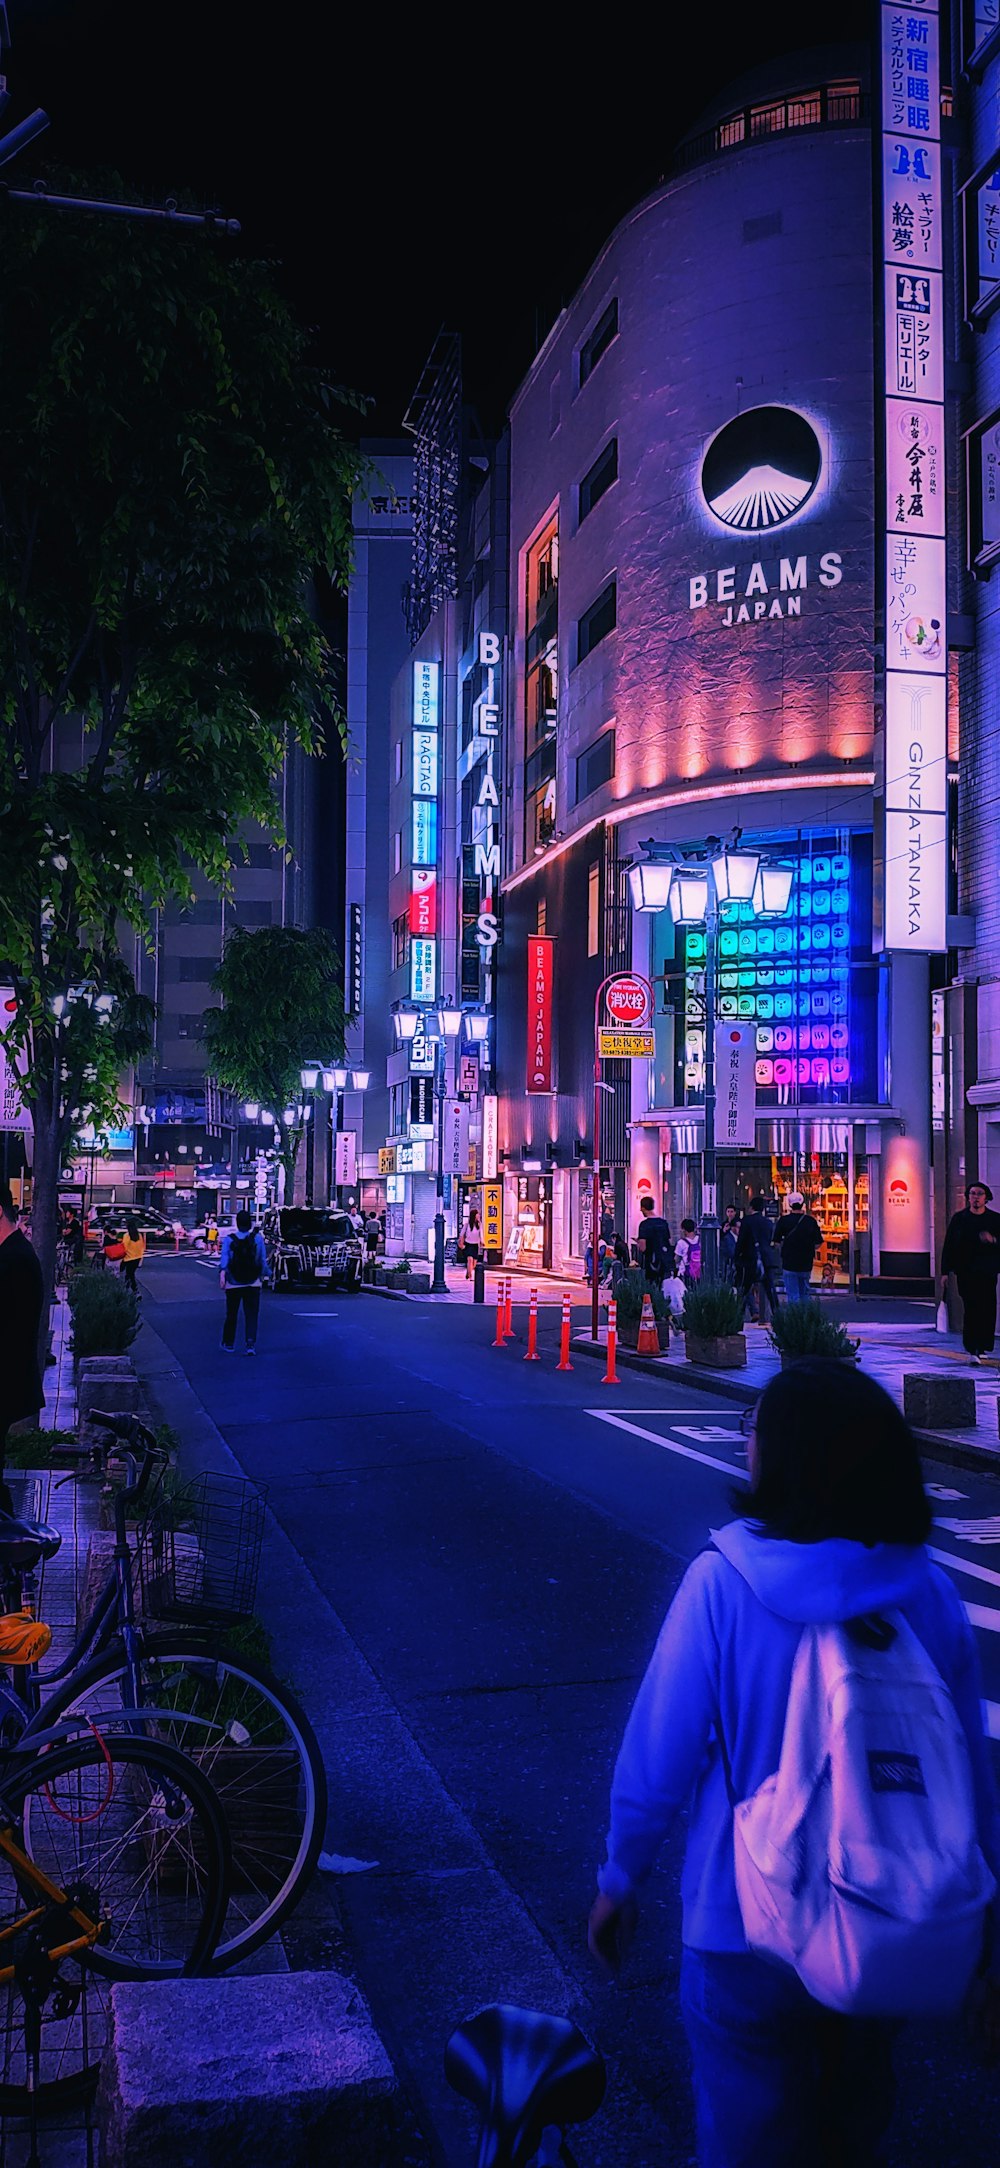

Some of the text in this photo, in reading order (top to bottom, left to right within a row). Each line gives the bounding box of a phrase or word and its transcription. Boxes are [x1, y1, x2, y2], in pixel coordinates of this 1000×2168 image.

[891, 15, 905, 125] メディカルクリニック
[906, 17, 930, 131] 新宿睡眠
[892, 201, 914, 252] 絵夢
[917, 192, 934, 253] ギャラリー
[899, 317, 913, 389] モリエール
[917, 319, 930, 377] シアター
[910, 416, 920, 439] 新宿
[905, 442, 926, 518] 今井屋
[689, 552, 843, 610] BEAMS
[889, 538, 917, 661] 幸せのパンケーキ
[722, 595, 802, 628] JAPAN
[420, 735, 431, 793] RAGTAG
[474, 632, 501, 946] BEAMS
[419, 895, 430, 925] アコム
[535, 946, 545, 1067] BEAMS JAPAN
[610, 992, 644, 1010] 消火栓
[464, 1062, 476, 1079] 占
[728, 1049, 740, 1138] 奉祝 天皇陛下御即位
[488, 1189, 498, 1235] 不動産
